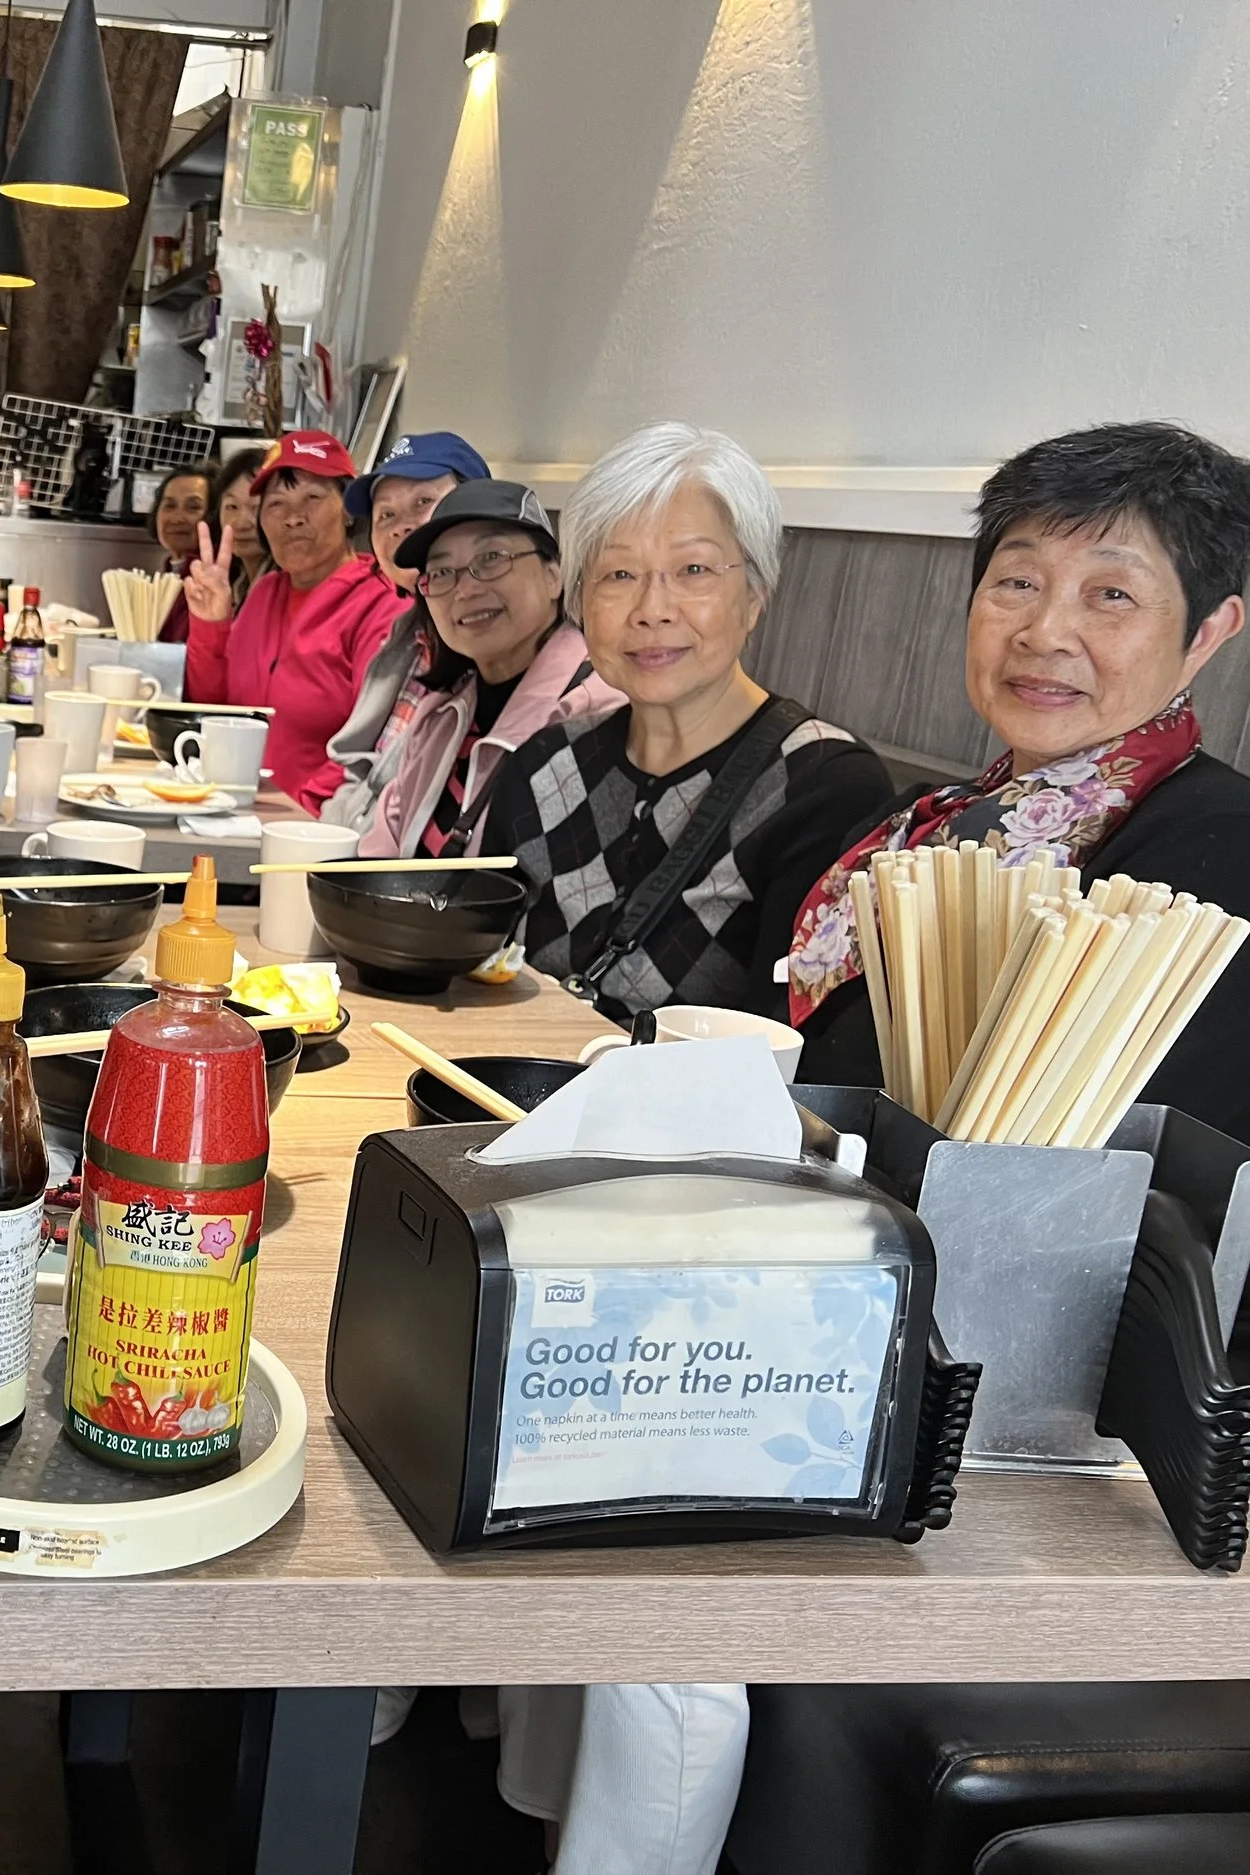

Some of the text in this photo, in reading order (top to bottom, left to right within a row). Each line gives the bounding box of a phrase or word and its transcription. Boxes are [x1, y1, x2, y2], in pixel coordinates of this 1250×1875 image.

[265, 120, 309, 138] PASS
[122, 1199, 195, 1237] 盛記
[106, 1225, 192, 1251] SHING KEE
[152, 1256, 208, 1268] HONG KONG
[546, 1288, 584, 1301] TORK
[99, 1294, 229, 1336] 是拉差辣椒醬
[87, 1344, 119, 1369] HOT
[182, 1359, 231, 1380] SAUCE
[116, 1339, 207, 1361] SRIRACHA
[526, 1336, 752, 1367] Good for you.
[520, 1367, 855, 1399] Good for the planet.
[516, 1407, 758, 1427] One napkin at a time means better health.
[74, 1415, 88, 1435] NET
[89, 1424, 105, 1446] WT.
[106, 1434, 118, 1450] 28
[120, 1438, 139, 1455] OZ.
[141, 1441, 151, 1459] (1
[155, 1445, 173, 1458] LB.
[176, 1445, 188, 1457] 12
[515, 1426, 751, 1444] 100% recycled material means less waste.
